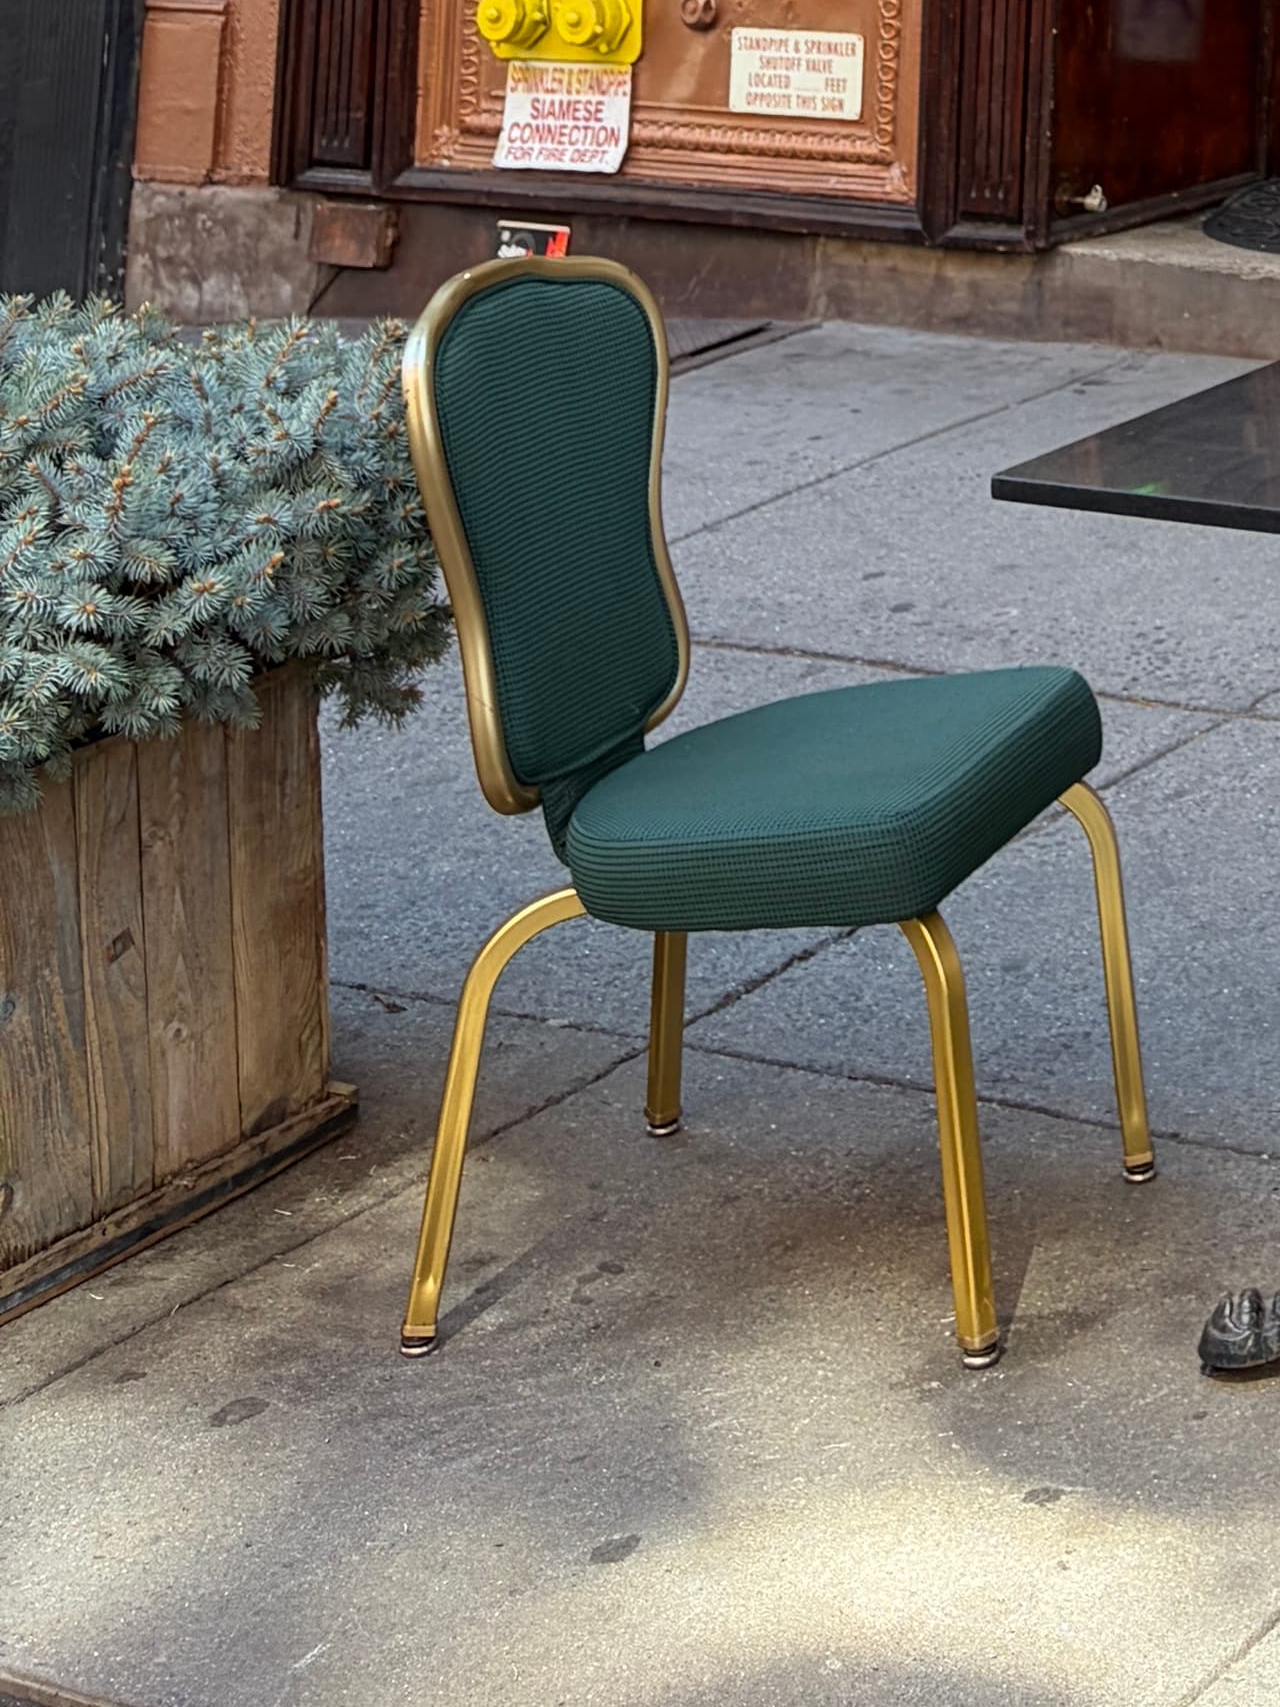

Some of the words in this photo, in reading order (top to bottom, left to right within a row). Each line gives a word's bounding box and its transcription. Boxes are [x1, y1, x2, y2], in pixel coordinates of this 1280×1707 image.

[738, 36, 789, 54] STANDPIPE
[794, 39, 800, 54] &
[804, 39, 857, 57] SPRINKLER
[759, 55, 802, 73] SHUTOFF
[806, 58, 833, 74] VALVE
[510, 64, 564, 94] SPRINKLER
[748, 72, 791, 90] LOCATED
[825, 77, 847, 93] FEET
[530, 97, 605, 123] SIAMESE
[746, 92, 792, 110] OPPOSITE
[796, 94, 817, 111] THIS
[821, 96, 844, 112] SIGN
[507, 121, 621, 148] CONNECTION
[504, 146, 532, 161] FOR
[535, 147, 568, 163] FIRE
[569, 148, 611, 165] DEPT.
